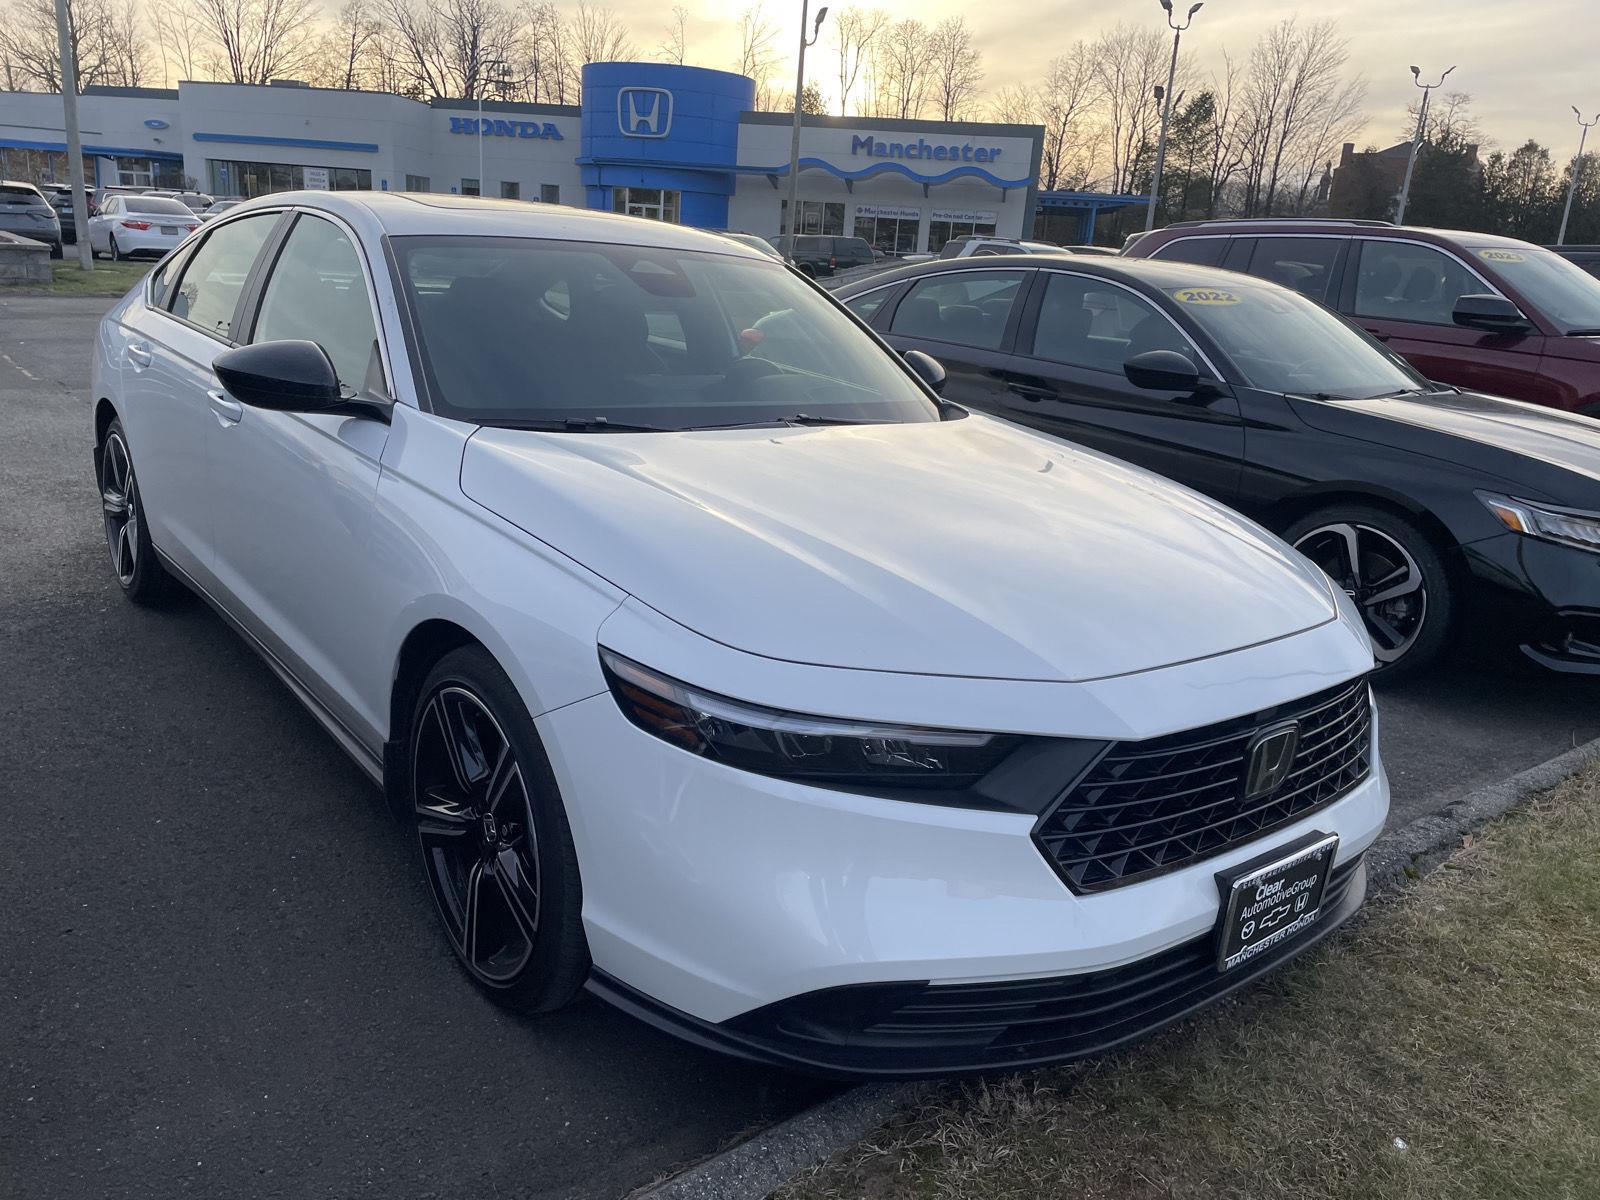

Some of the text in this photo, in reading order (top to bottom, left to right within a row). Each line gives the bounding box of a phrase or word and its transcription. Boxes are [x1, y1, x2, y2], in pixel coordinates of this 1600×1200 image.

[450, 117, 564, 140] HONDA
[851, 134, 1002, 162] Manchester
[1183, 291, 1237, 302] 2022
[1240, 874, 1318, 921] AutomotiveGroup
[1255, 879, 1285, 901] Clear
[1226, 913, 1316, 970] MANCHESTER HONDA
